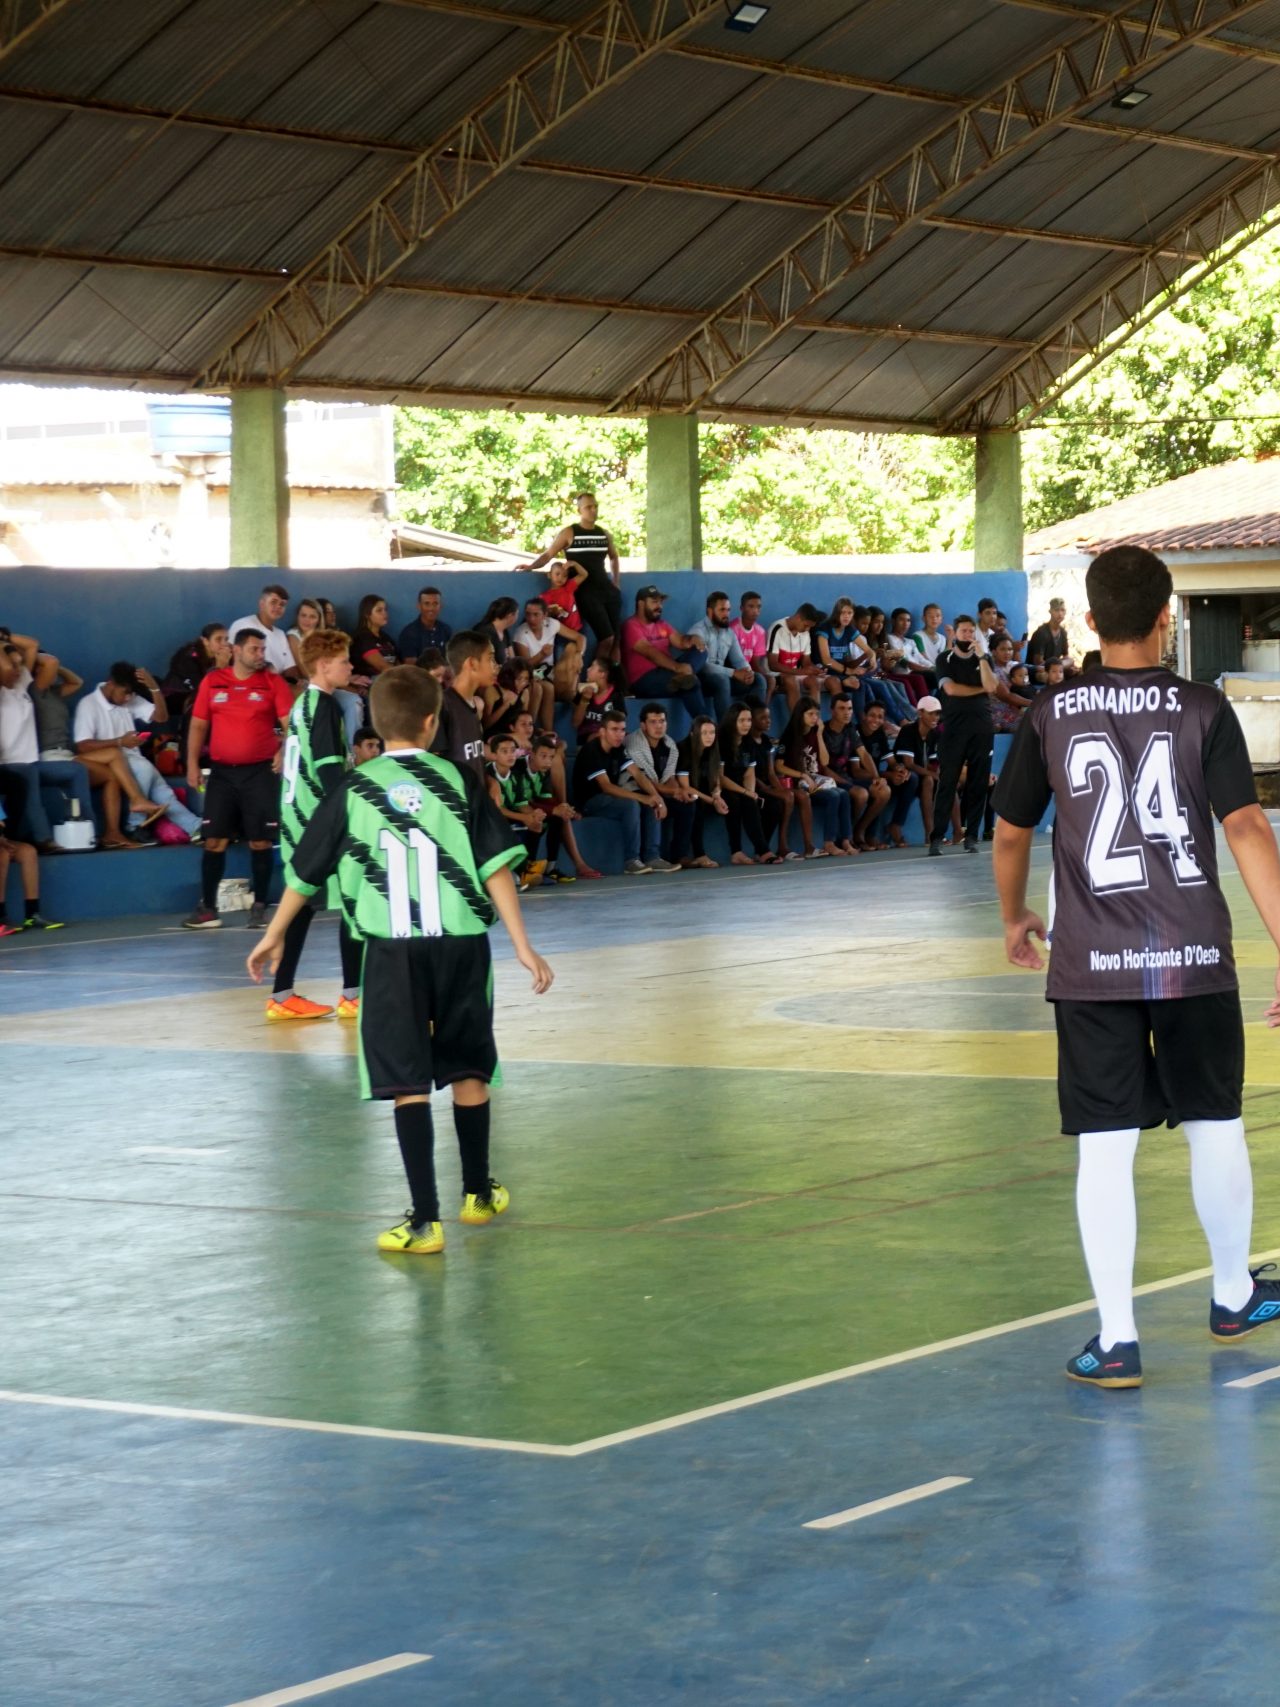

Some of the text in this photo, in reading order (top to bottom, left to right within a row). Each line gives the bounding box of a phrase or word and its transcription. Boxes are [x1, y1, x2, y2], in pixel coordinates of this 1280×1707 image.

[1053, 685, 1182, 720] FERNANDO S.
[283, 734, 301, 804] 9
[1065, 731, 1208, 896] 24
[378, 828, 443, 939] 11
[1089, 944, 1220, 971] Novo Horizonte D'Oeste
